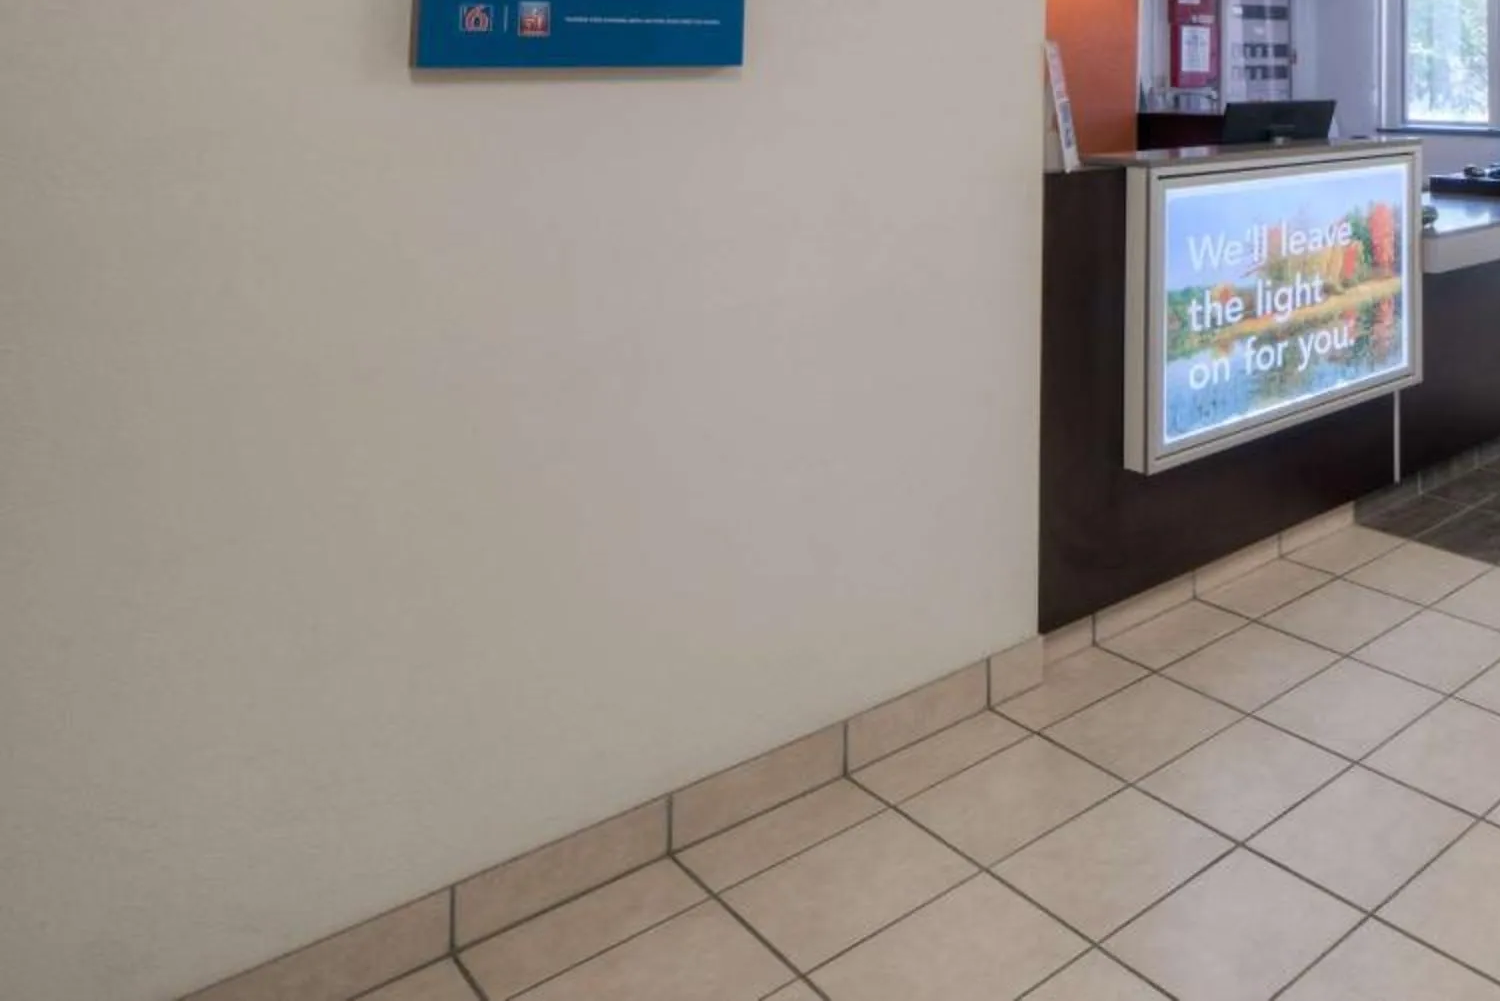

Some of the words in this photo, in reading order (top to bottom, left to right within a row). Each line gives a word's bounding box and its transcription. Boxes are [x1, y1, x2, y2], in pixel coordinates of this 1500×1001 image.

[1187, 224, 1269, 272] We'll
[1280, 219, 1352, 255] leave
[1188, 290, 1245, 333] the
[1256, 273, 1324, 324] light
[1188, 357, 1231, 390] on
[1243, 335, 1290, 376] for
[1298, 324, 1357, 371] you.
